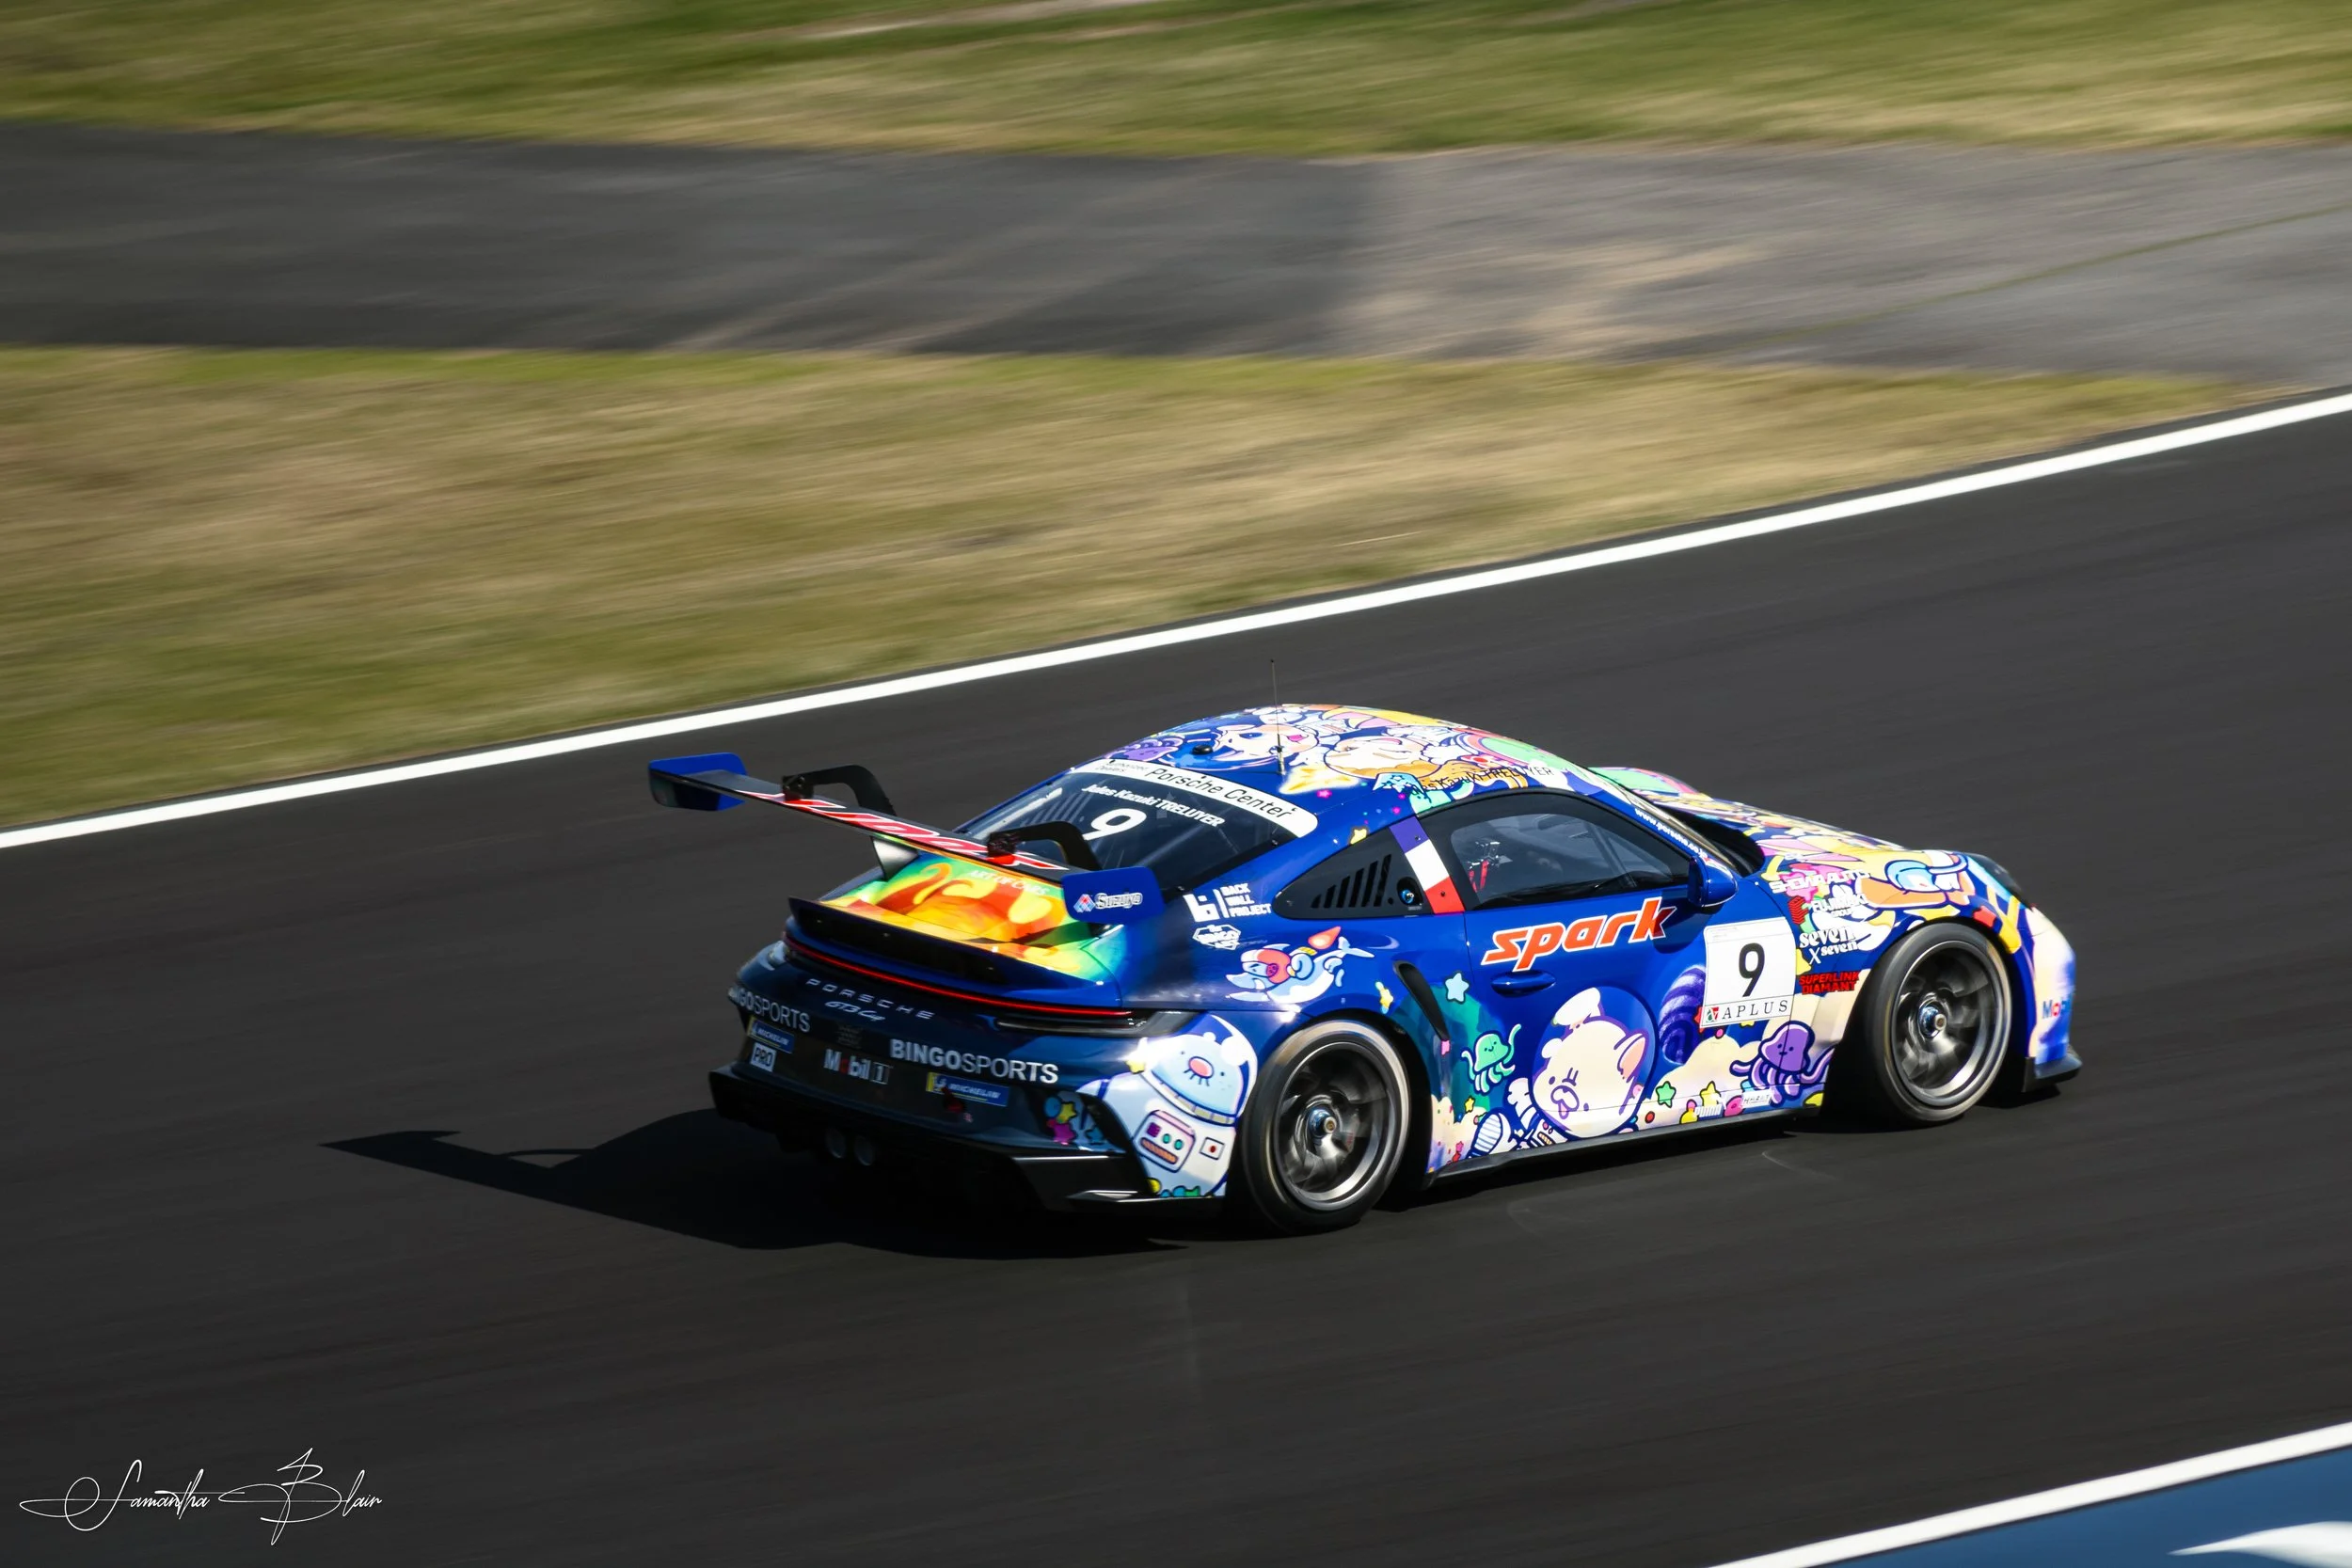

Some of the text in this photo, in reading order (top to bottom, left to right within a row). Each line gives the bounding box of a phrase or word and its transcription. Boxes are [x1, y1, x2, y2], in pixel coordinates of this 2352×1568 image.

[1146, 768, 1295, 818] Porsche Center
[1082, 808, 1148, 841] 9
[1481, 896, 1677, 973] spark
[1799, 926, 1856, 948] seven
[1820, 941, 1859, 957] seven
[1739, 942, 1765, 998] 9
[1799, 970, 1860, 987] SUPERLINK
[805, 978, 936, 1021] PORSCHE
[1801, 980, 1856, 996] DIAMANT
[754, 1046, 773, 1068] PRO
[823, 1047, 872, 1081] Mobil
[889, 1038, 1059, 1085] BINGOSPORTS
